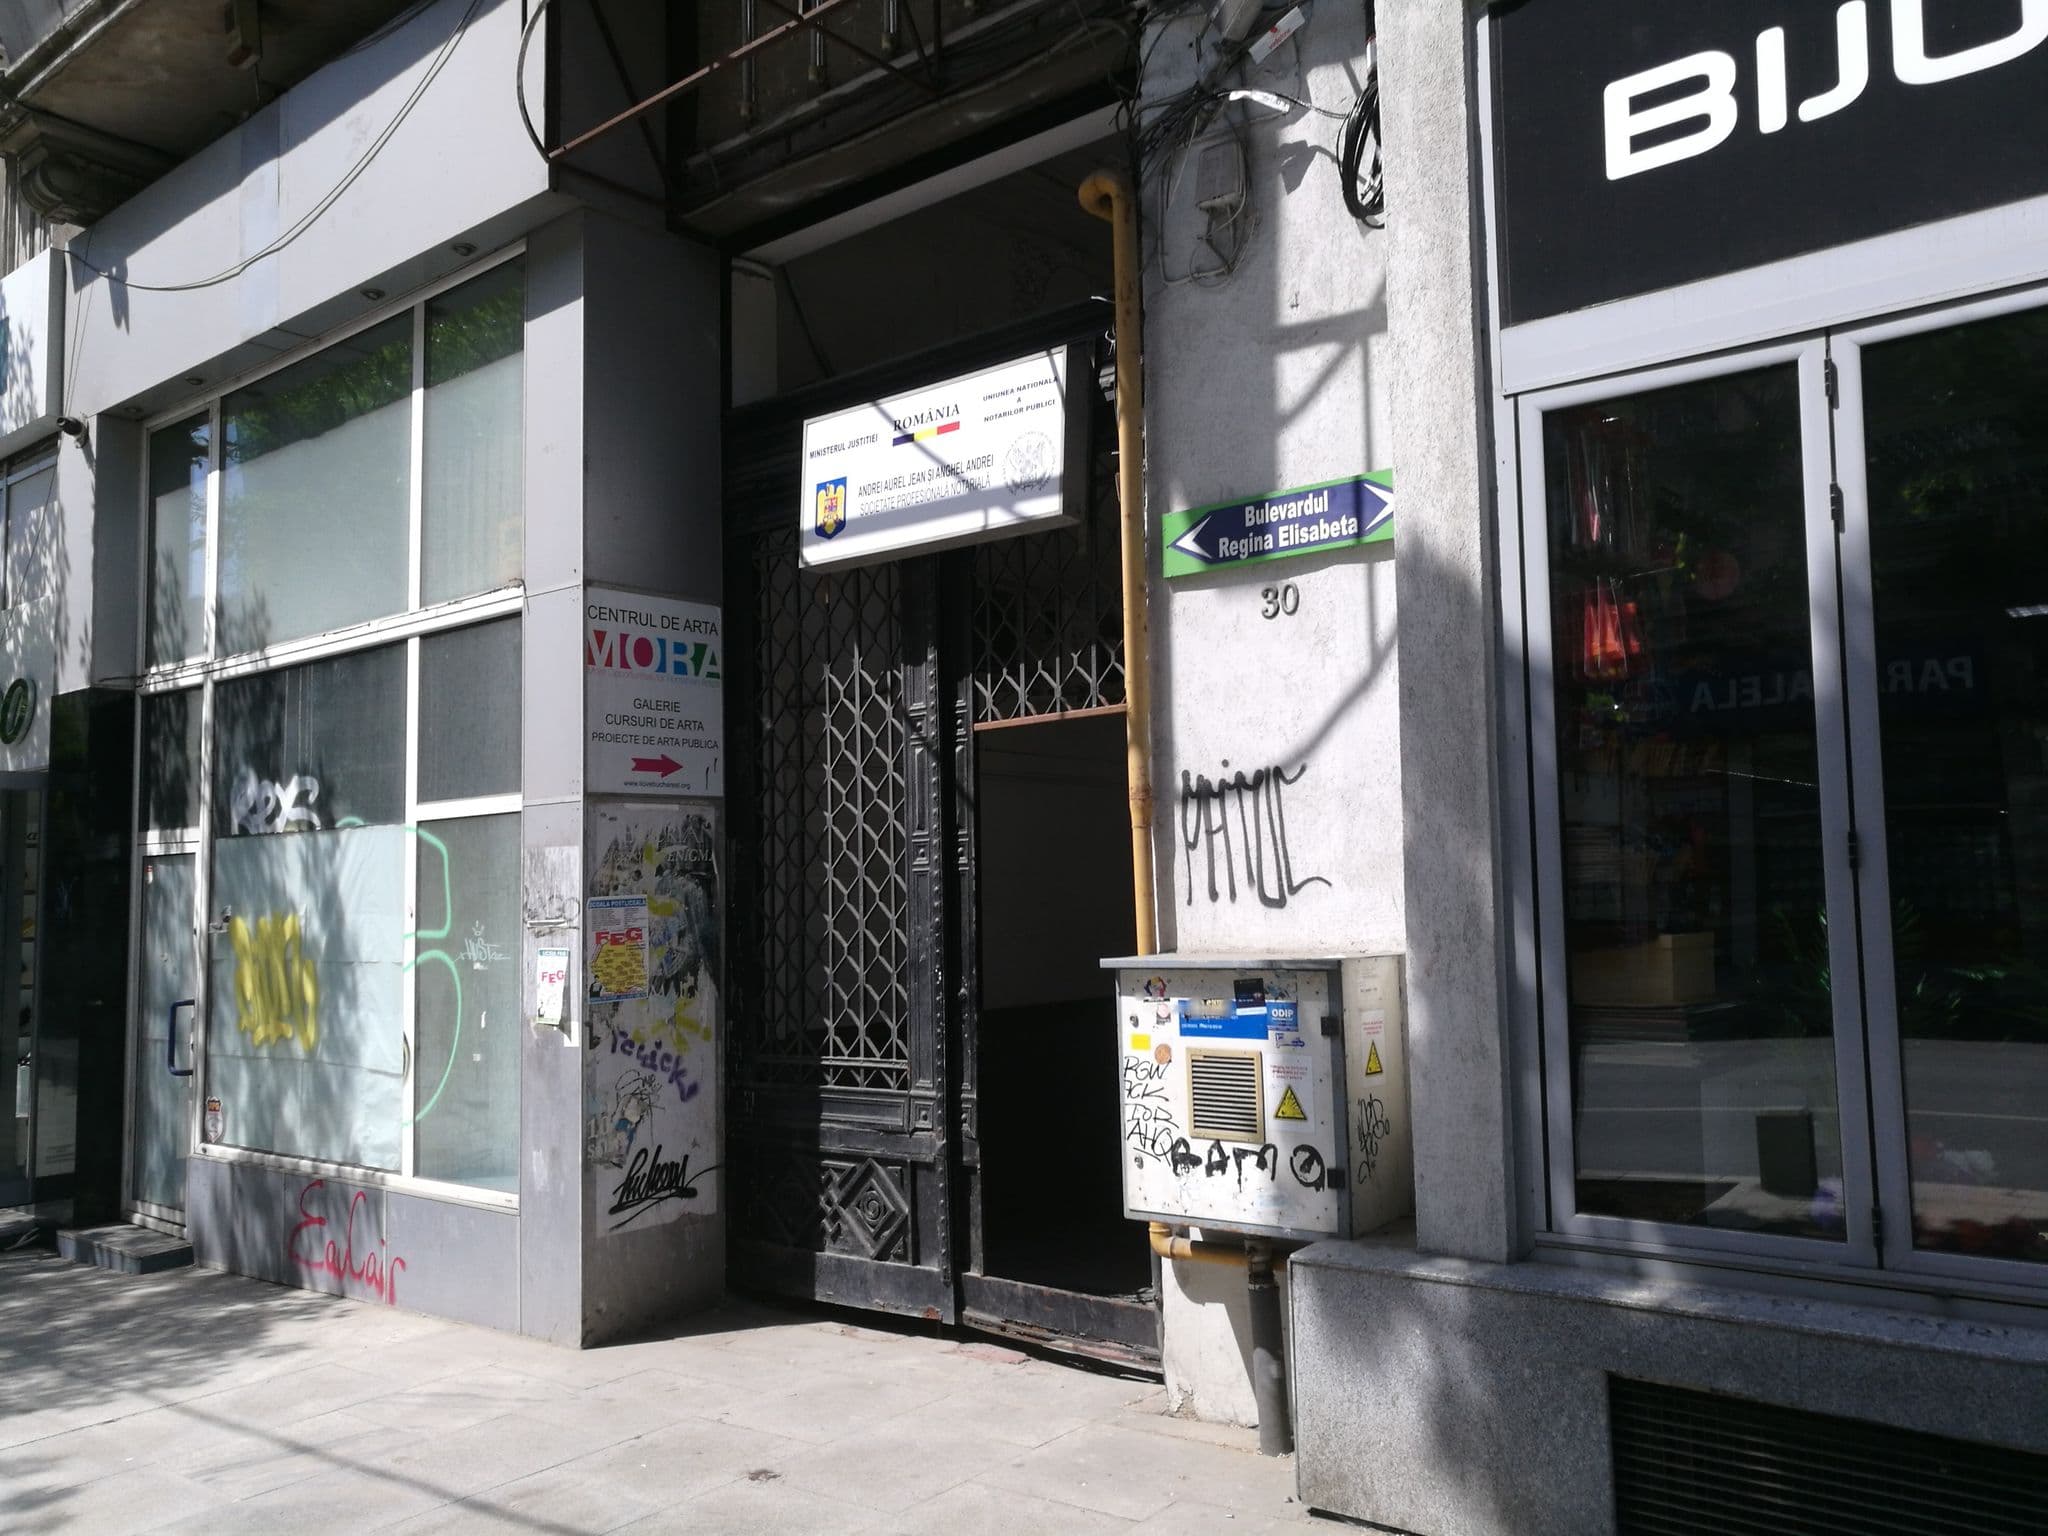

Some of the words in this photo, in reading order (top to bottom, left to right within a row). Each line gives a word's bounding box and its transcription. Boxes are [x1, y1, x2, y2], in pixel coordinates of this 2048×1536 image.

[983, 388, 1015, 402] UNIUNEA
[893, 403, 960, 432] ROMÂNIA
[984, 407, 1024, 423] NOTARILOR
[1026, 399, 1055, 412] PUBLICI
[809, 442, 846, 459] MINISTERUL
[858, 481, 882, 497] ANDREI
[883, 475, 906, 491] AUREL
[908, 471, 925, 487] JEAN
[936, 461, 964, 479] ANGHEL
[966, 454, 994, 470] ANDREI
[860, 496, 896, 516] SOCIETATE
[1245, 490, 1329, 528] Bulevardul
[1218, 532, 1273, 560] Regina
[1278, 513, 1358, 548] Elisabeta
[1261, 583, 1300, 620] 30
[588, 605, 656, 628] CENTRUL
[661, 616, 680, 631] DE
[683, 618, 719, 636] ARTA
[586, 629, 721, 680] MORA
[633, 698, 681, 713] GALERIE
[605, 713, 657, 728] CURSURI
[660, 718, 675, 730] DE
[677, 719, 704, 732] ARTA
[592, 732, 640, 744] PROIECTE
[643, 735, 655, 745] DE
[657, 736, 681, 747] ARTA
[682, 738, 719, 749] PUBLICA
[595, 927, 643, 946] FEG
[541, 970, 566, 984] FEG
